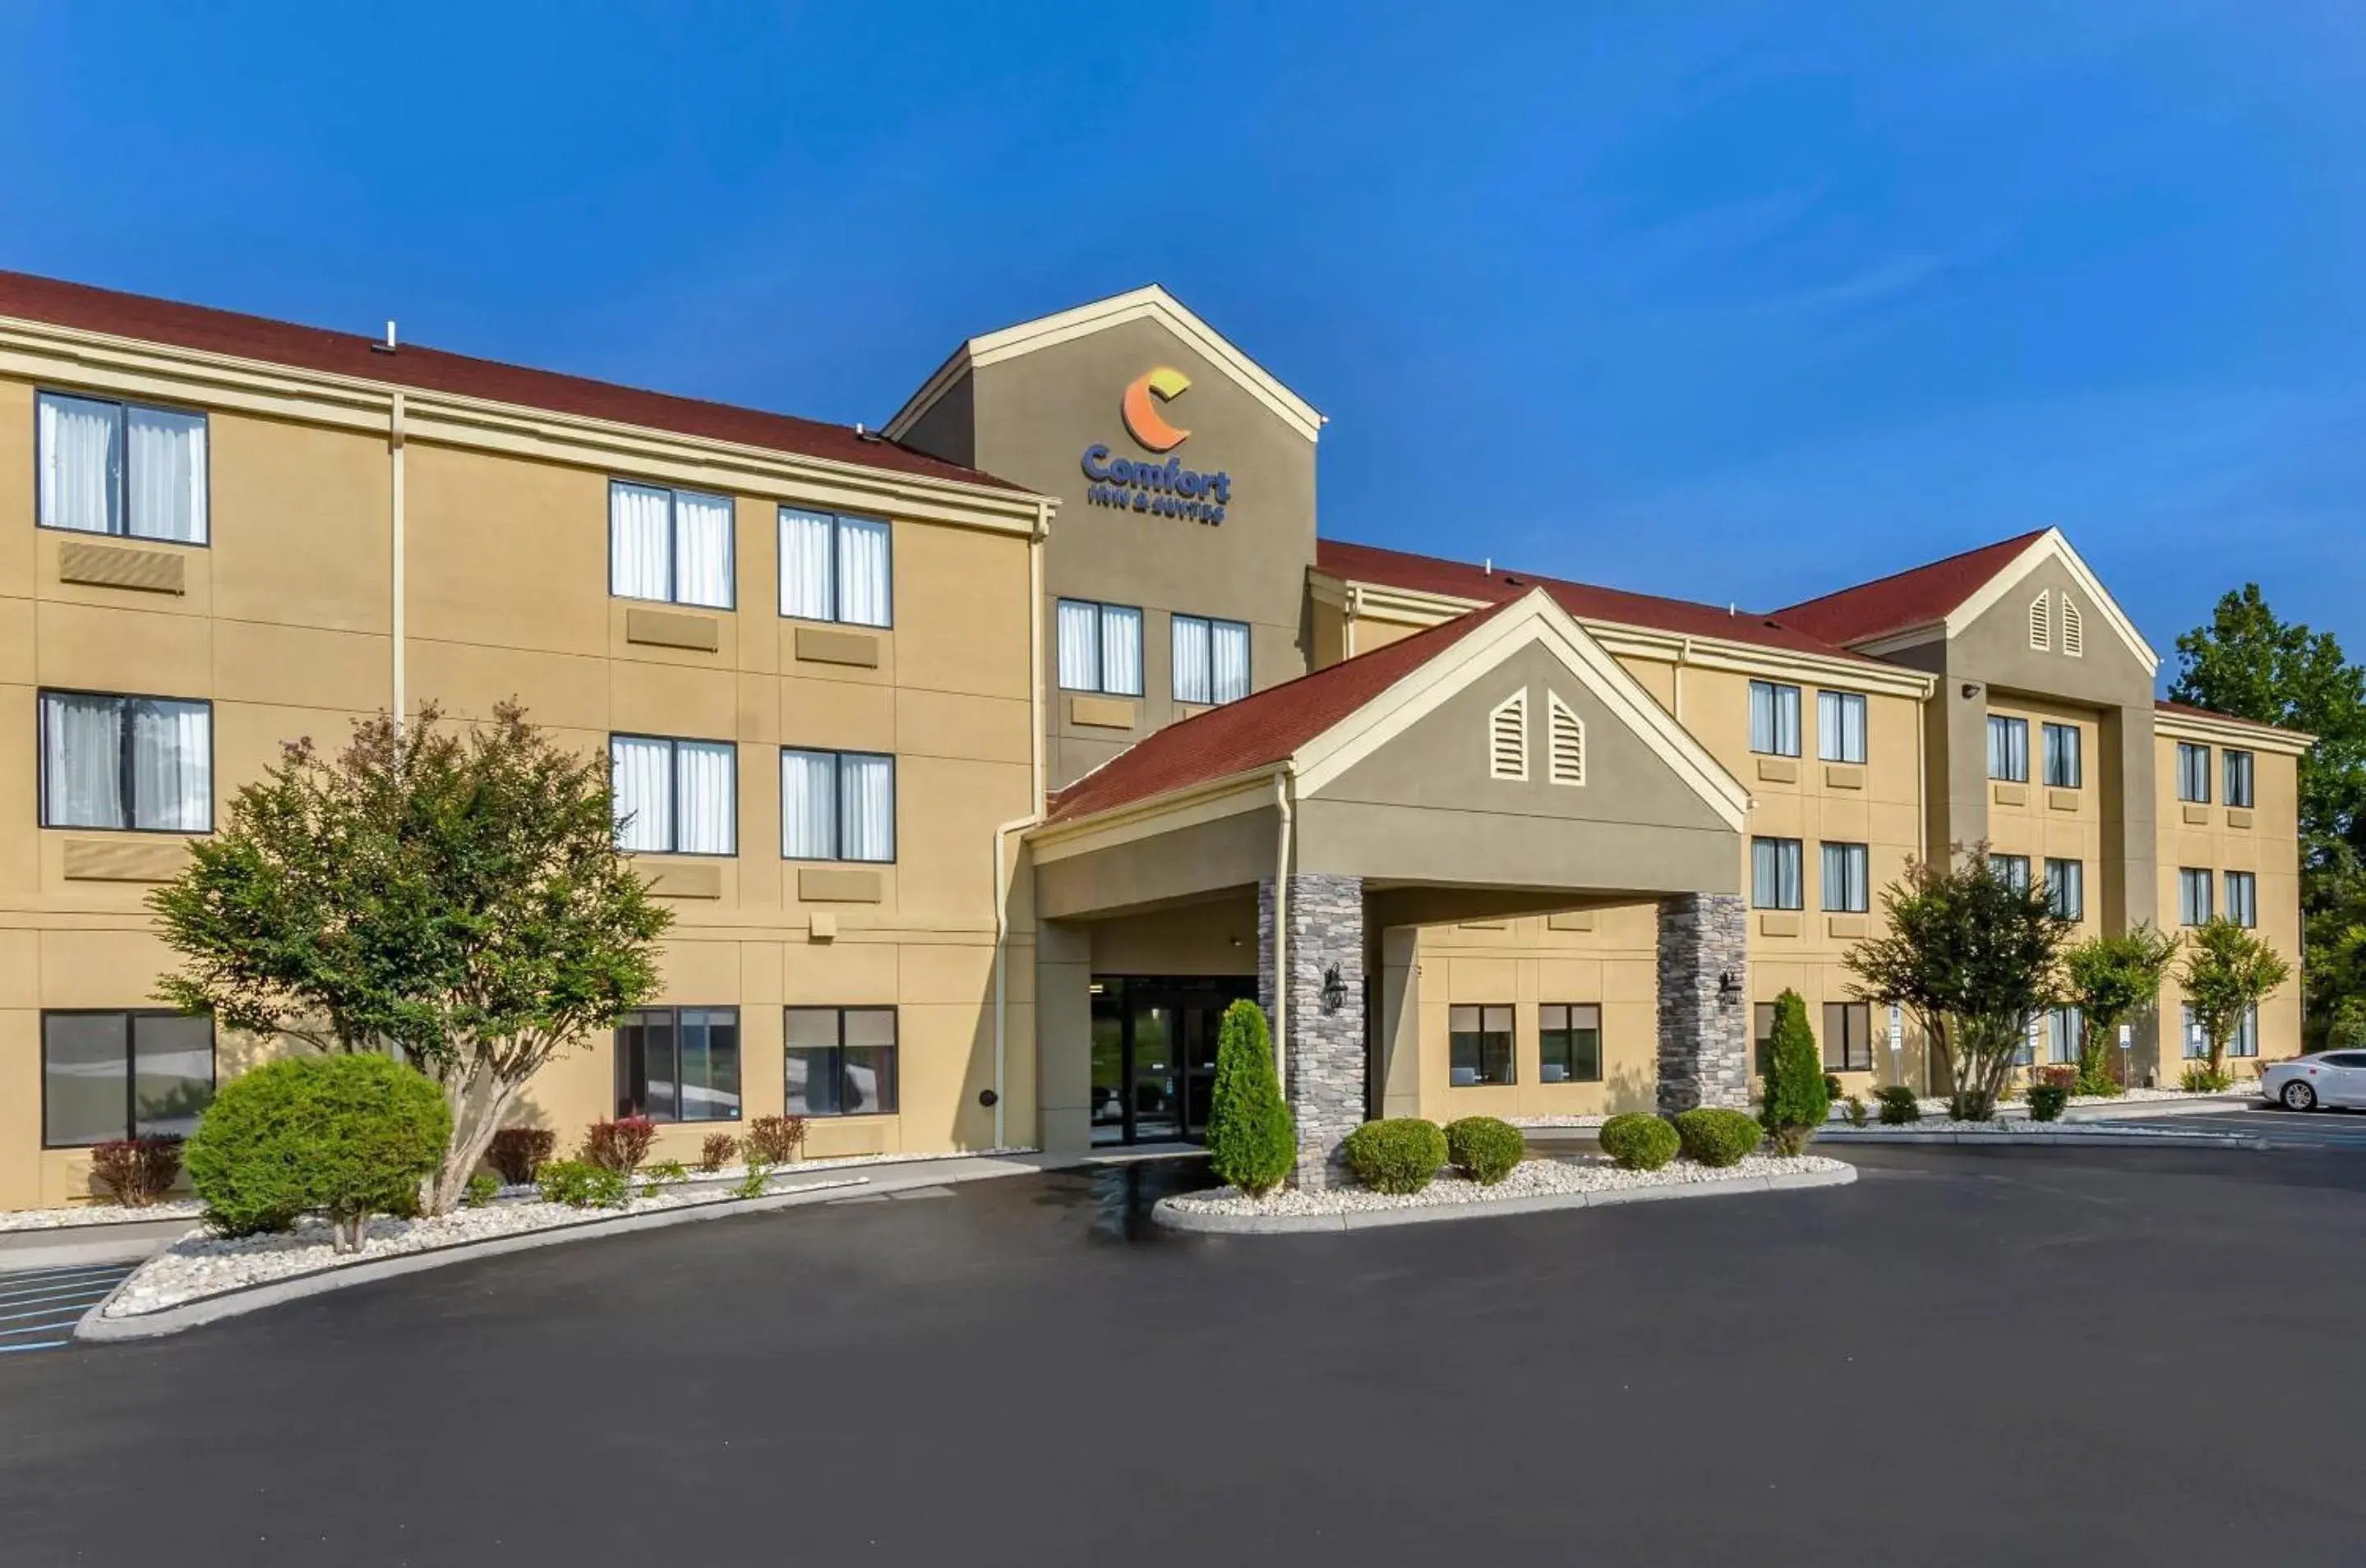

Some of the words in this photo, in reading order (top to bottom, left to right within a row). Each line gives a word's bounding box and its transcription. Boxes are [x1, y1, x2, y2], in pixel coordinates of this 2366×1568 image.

[1081, 442, 1231, 503] Comfort
[1088, 484, 1130, 510] INN
[1151, 496, 1225, 527] SUITES
